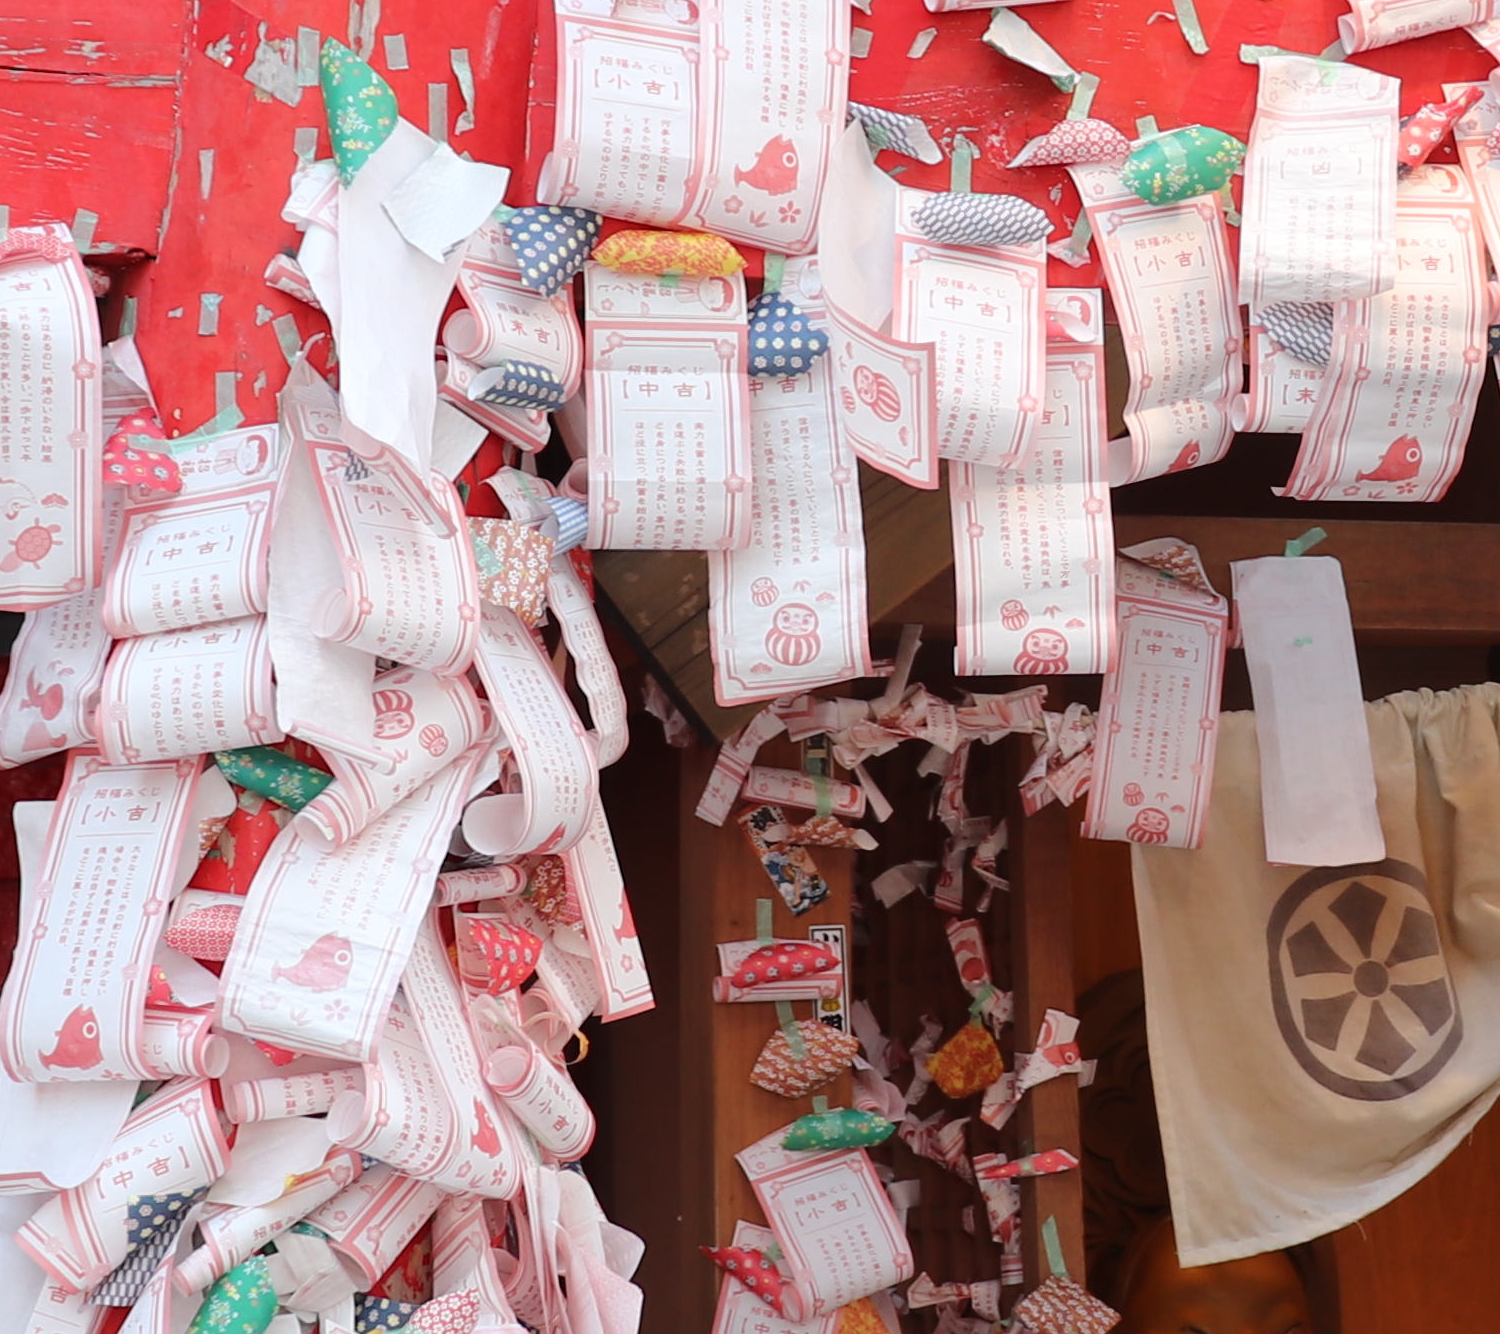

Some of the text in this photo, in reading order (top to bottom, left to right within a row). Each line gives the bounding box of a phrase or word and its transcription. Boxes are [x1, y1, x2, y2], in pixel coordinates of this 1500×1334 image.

[599, 55, 673, 75] 招福みくじ
[935, 276, 1006, 299] 招福みくじ
[627, 365, 704, 376] 招福みくじ
[94, 786, 162, 799] 招福みくじ
[99, 1131, 175, 1170] 招福みくじ
